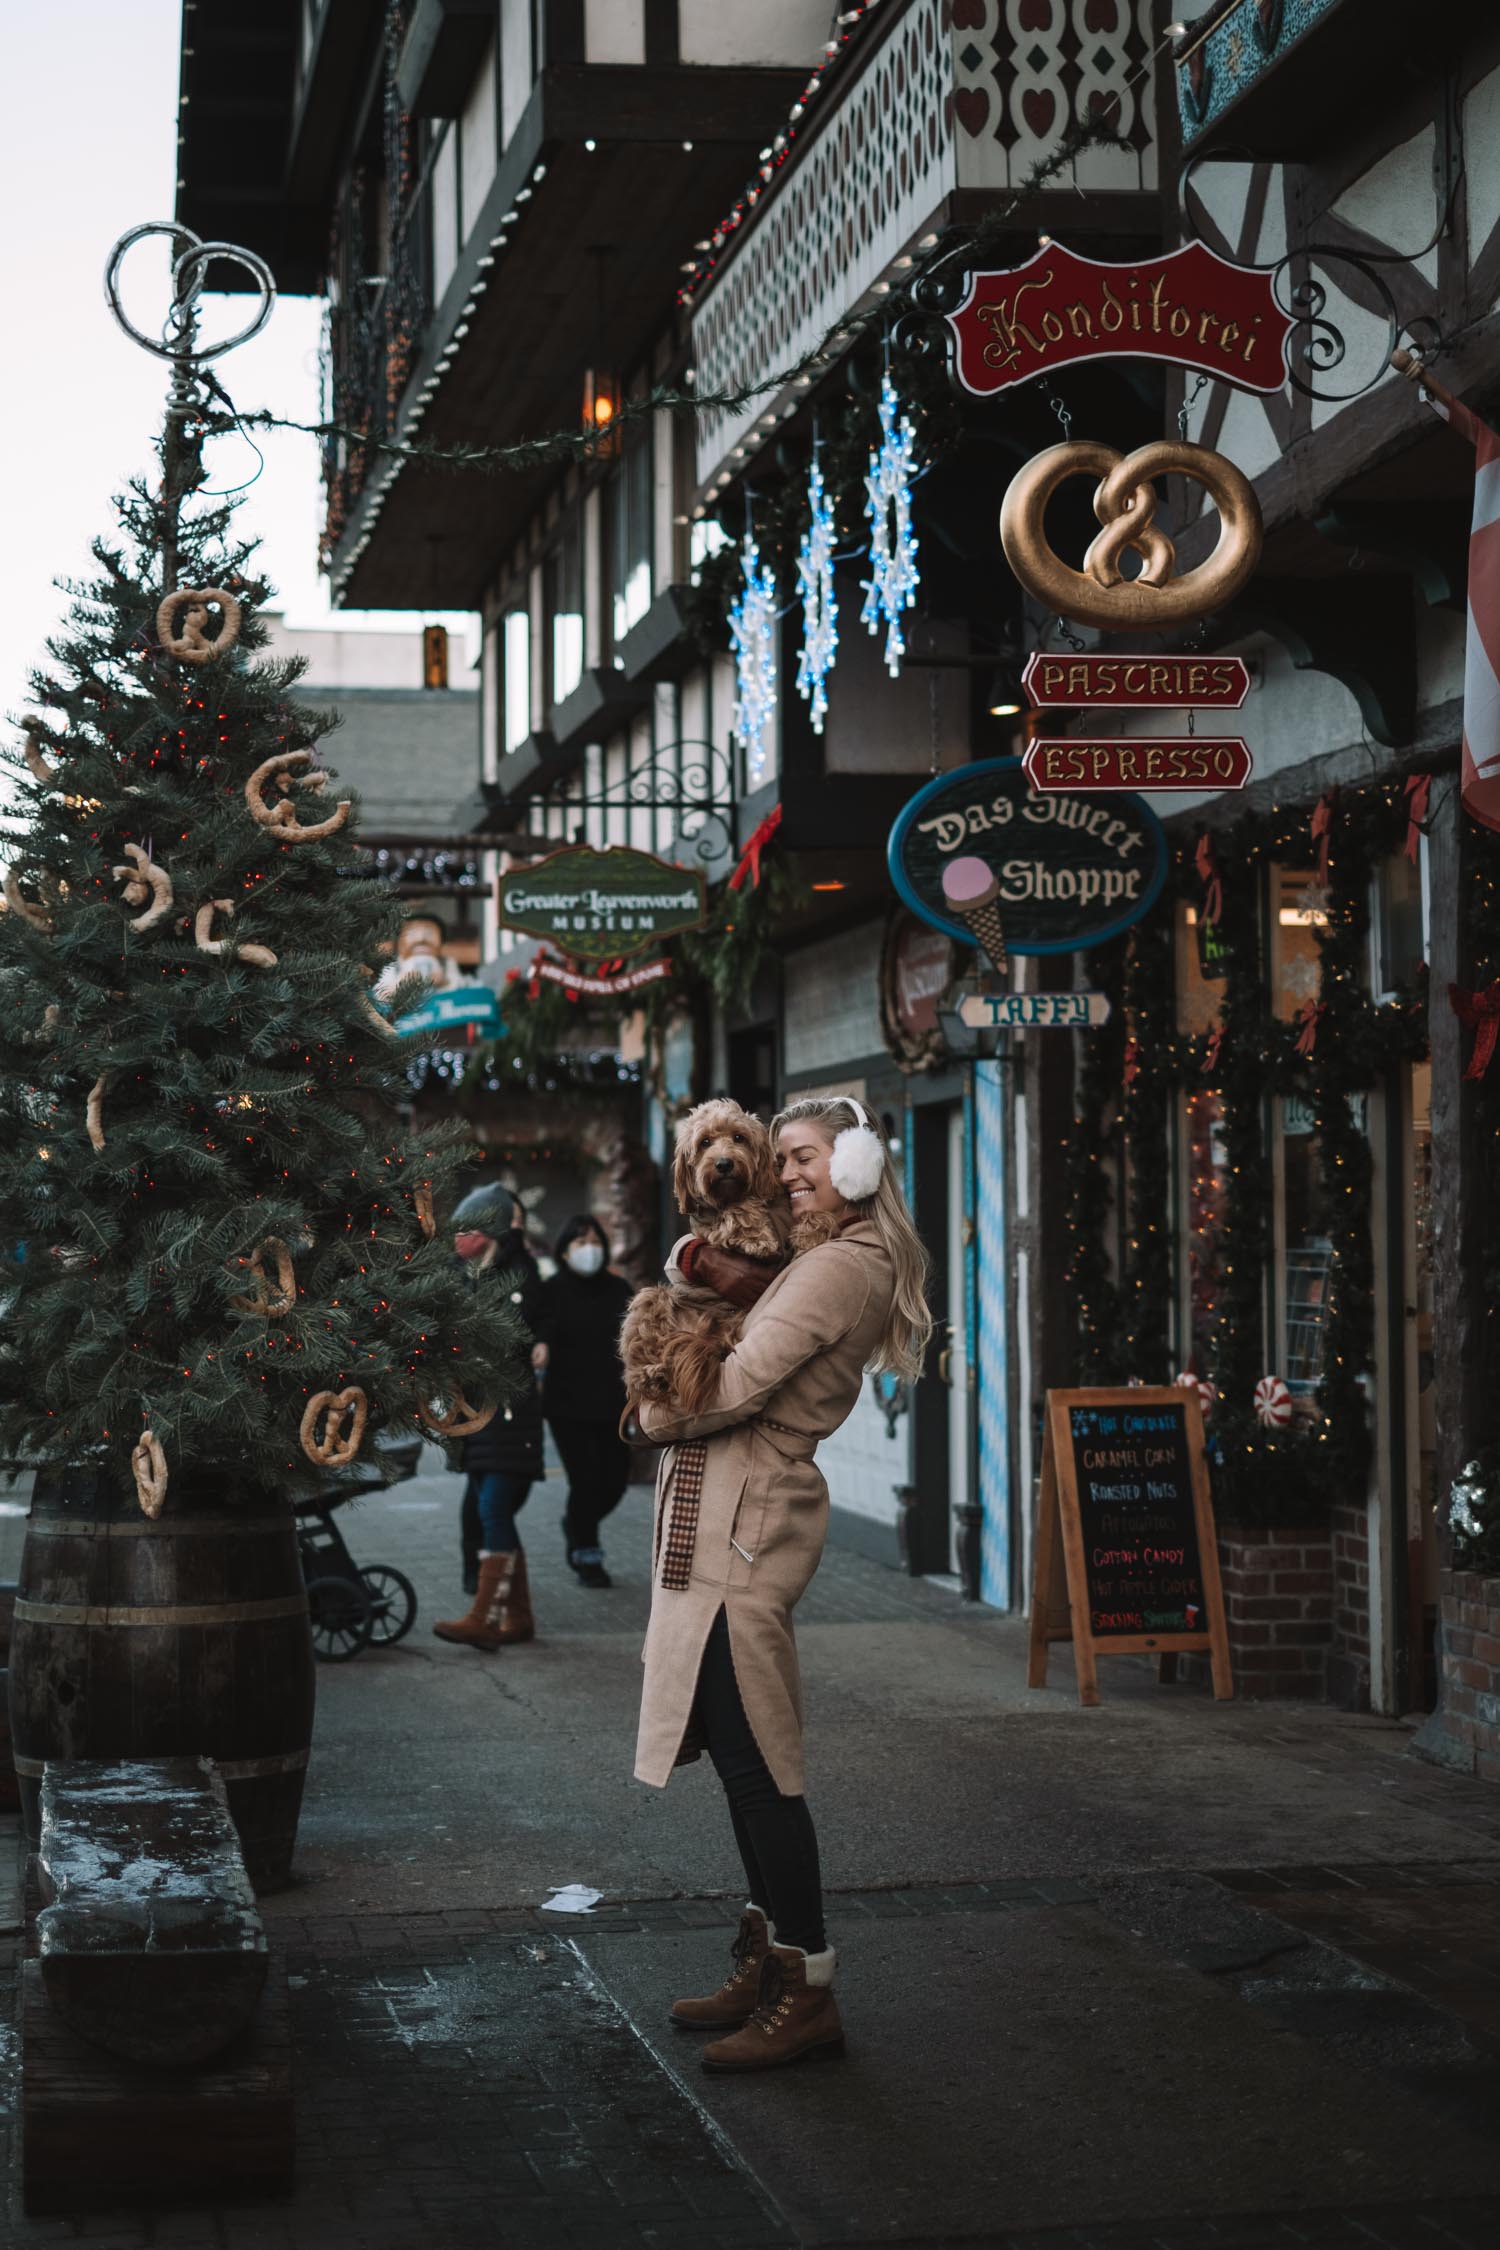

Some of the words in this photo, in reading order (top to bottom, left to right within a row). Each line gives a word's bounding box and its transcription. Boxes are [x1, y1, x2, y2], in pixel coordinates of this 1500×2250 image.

[976, 270, 1263, 370] Konditorei
[1042, 662, 1236, 696] PASTRIES
[1043, 746, 1235, 781] ESPRESSO
[918, 797, 1013, 852] Das
[1022, 788, 1145, 859] Sweet
[1001, 860, 1141, 907] Shoppe
[504, 889, 579, 914] Greater
[581, 889, 699, 916] Leavenworth
[552, 915, 655, 930] MUSEUM
[984, 996, 1091, 1025] TAFFY
[1083, 1448, 1141, 1470] CARAMEL
[1144, 1447, 1177, 1468] CORN
[1090, 1481, 1141, 1502] ROASTED
[1146, 1481, 1177, 1501] NUTS
[1092, 1547, 1139, 1568] COTTON
[1143, 1547, 1185, 1567] CANDY
